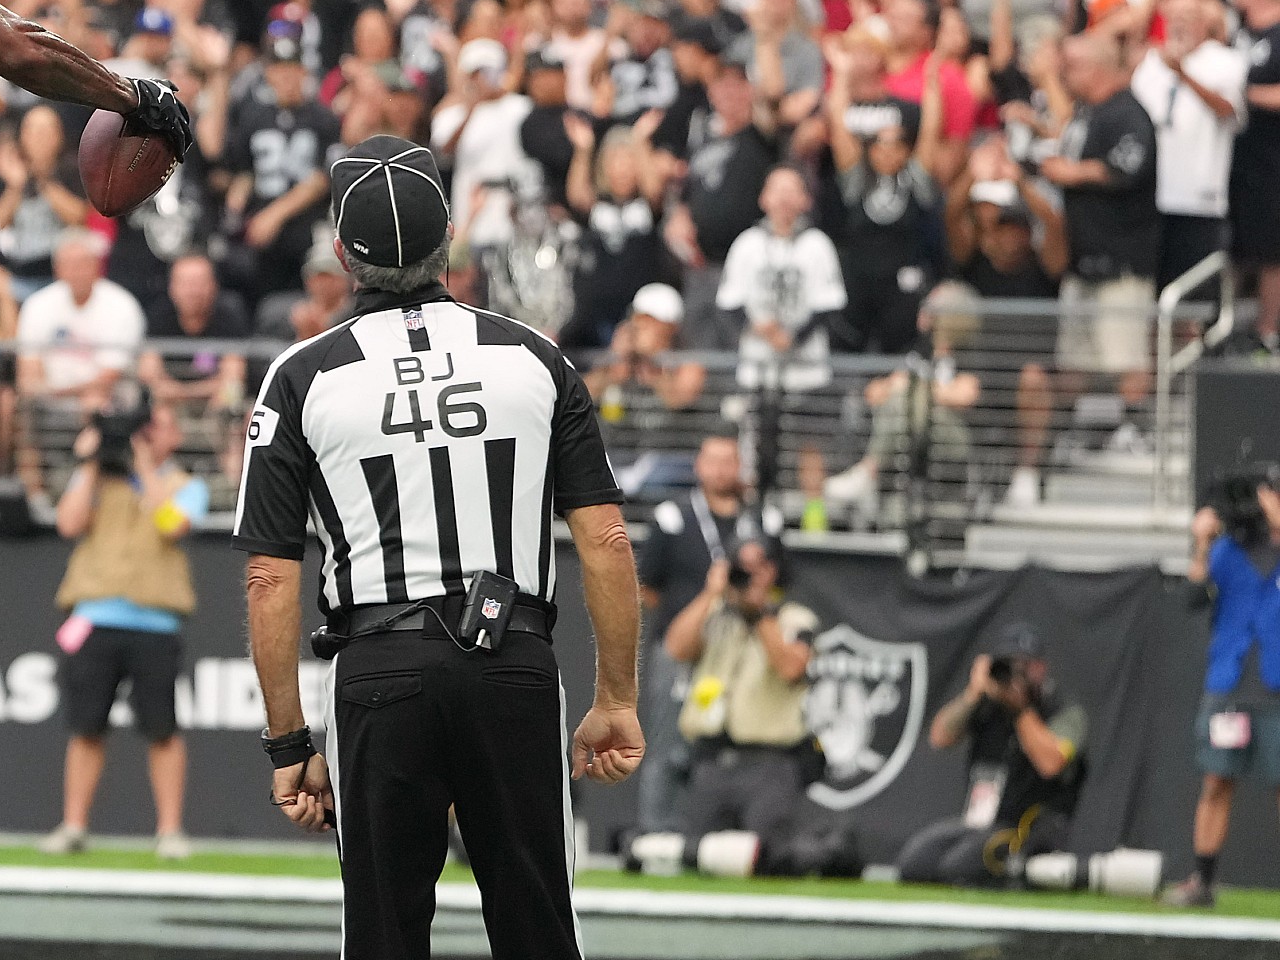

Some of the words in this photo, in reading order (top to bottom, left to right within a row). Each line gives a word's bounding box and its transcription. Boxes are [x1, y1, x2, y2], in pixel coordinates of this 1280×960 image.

[128, 148, 145, 173] LEAGUE
[353, 242, 370, 255] WM
[406, 319, 424, 329] NFL
[392, 352, 455, 386] BJ
[380, 381, 488, 443] 46
[484, 607, 497, 617] NFL
